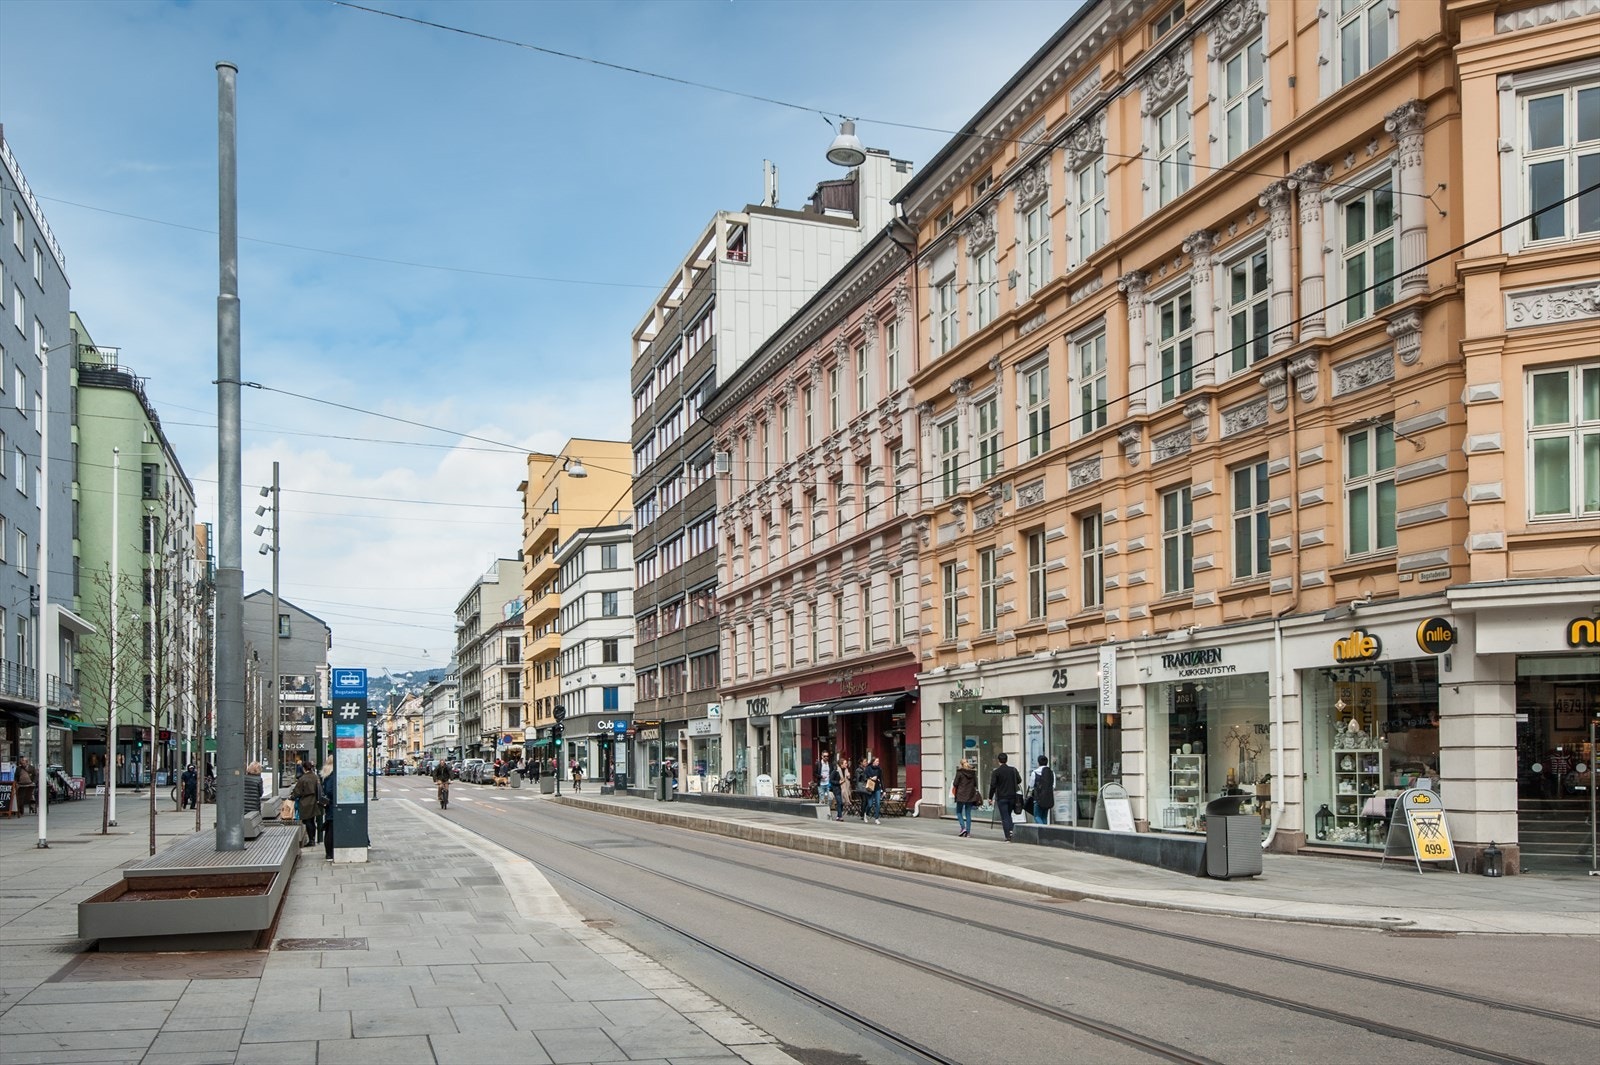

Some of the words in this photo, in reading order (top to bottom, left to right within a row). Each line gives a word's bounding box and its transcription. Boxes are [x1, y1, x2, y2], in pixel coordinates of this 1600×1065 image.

[1426, 626, 1452, 642] nille
[1333, 631, 1374, 660] nille
[1161, 647, 1222, 669] TRAKTØREN
[1052, 668, 1068, 689] 25
[1178, 664, 1237, 678] KJØKKENUTSTYR
[1102, 662, 1110, 707] TRAKTØREN
